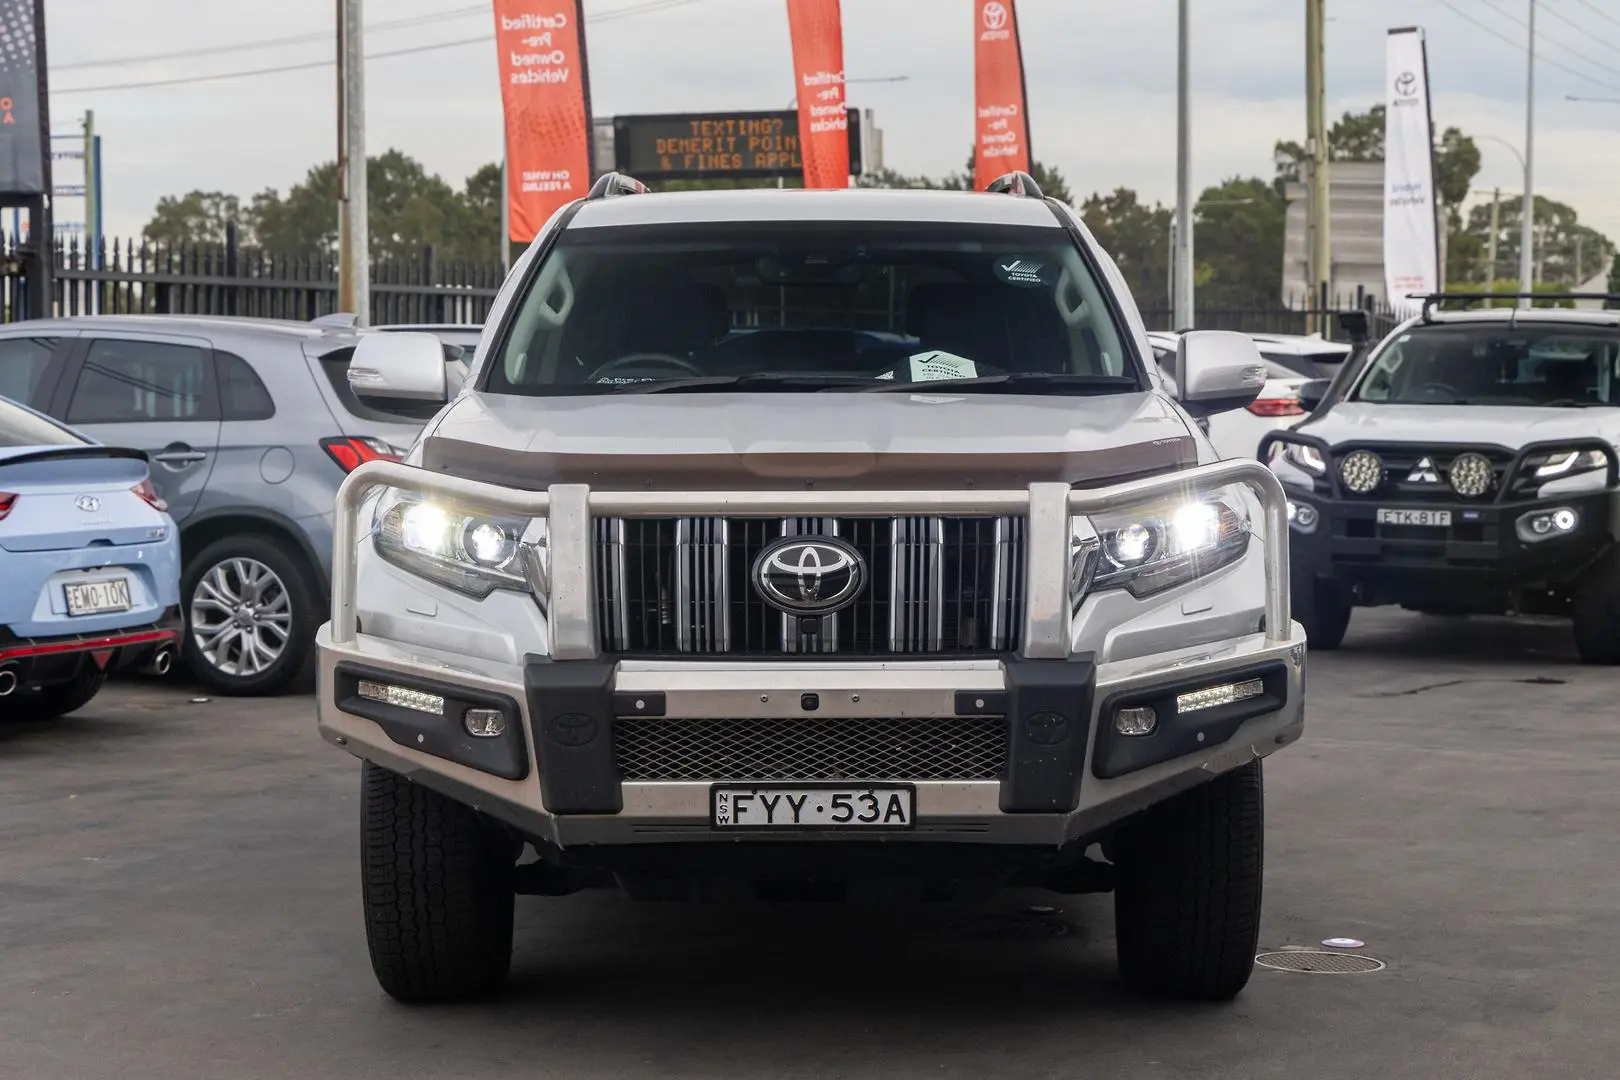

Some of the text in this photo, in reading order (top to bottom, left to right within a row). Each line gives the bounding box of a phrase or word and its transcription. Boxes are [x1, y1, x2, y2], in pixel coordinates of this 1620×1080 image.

[690, 118, 783, 136] TEXTING?
[656, 135, 800, 154] DEMERIT POIN
[684, 153, 742, 170] FINES
[755, 151, 802, 169] APPL
